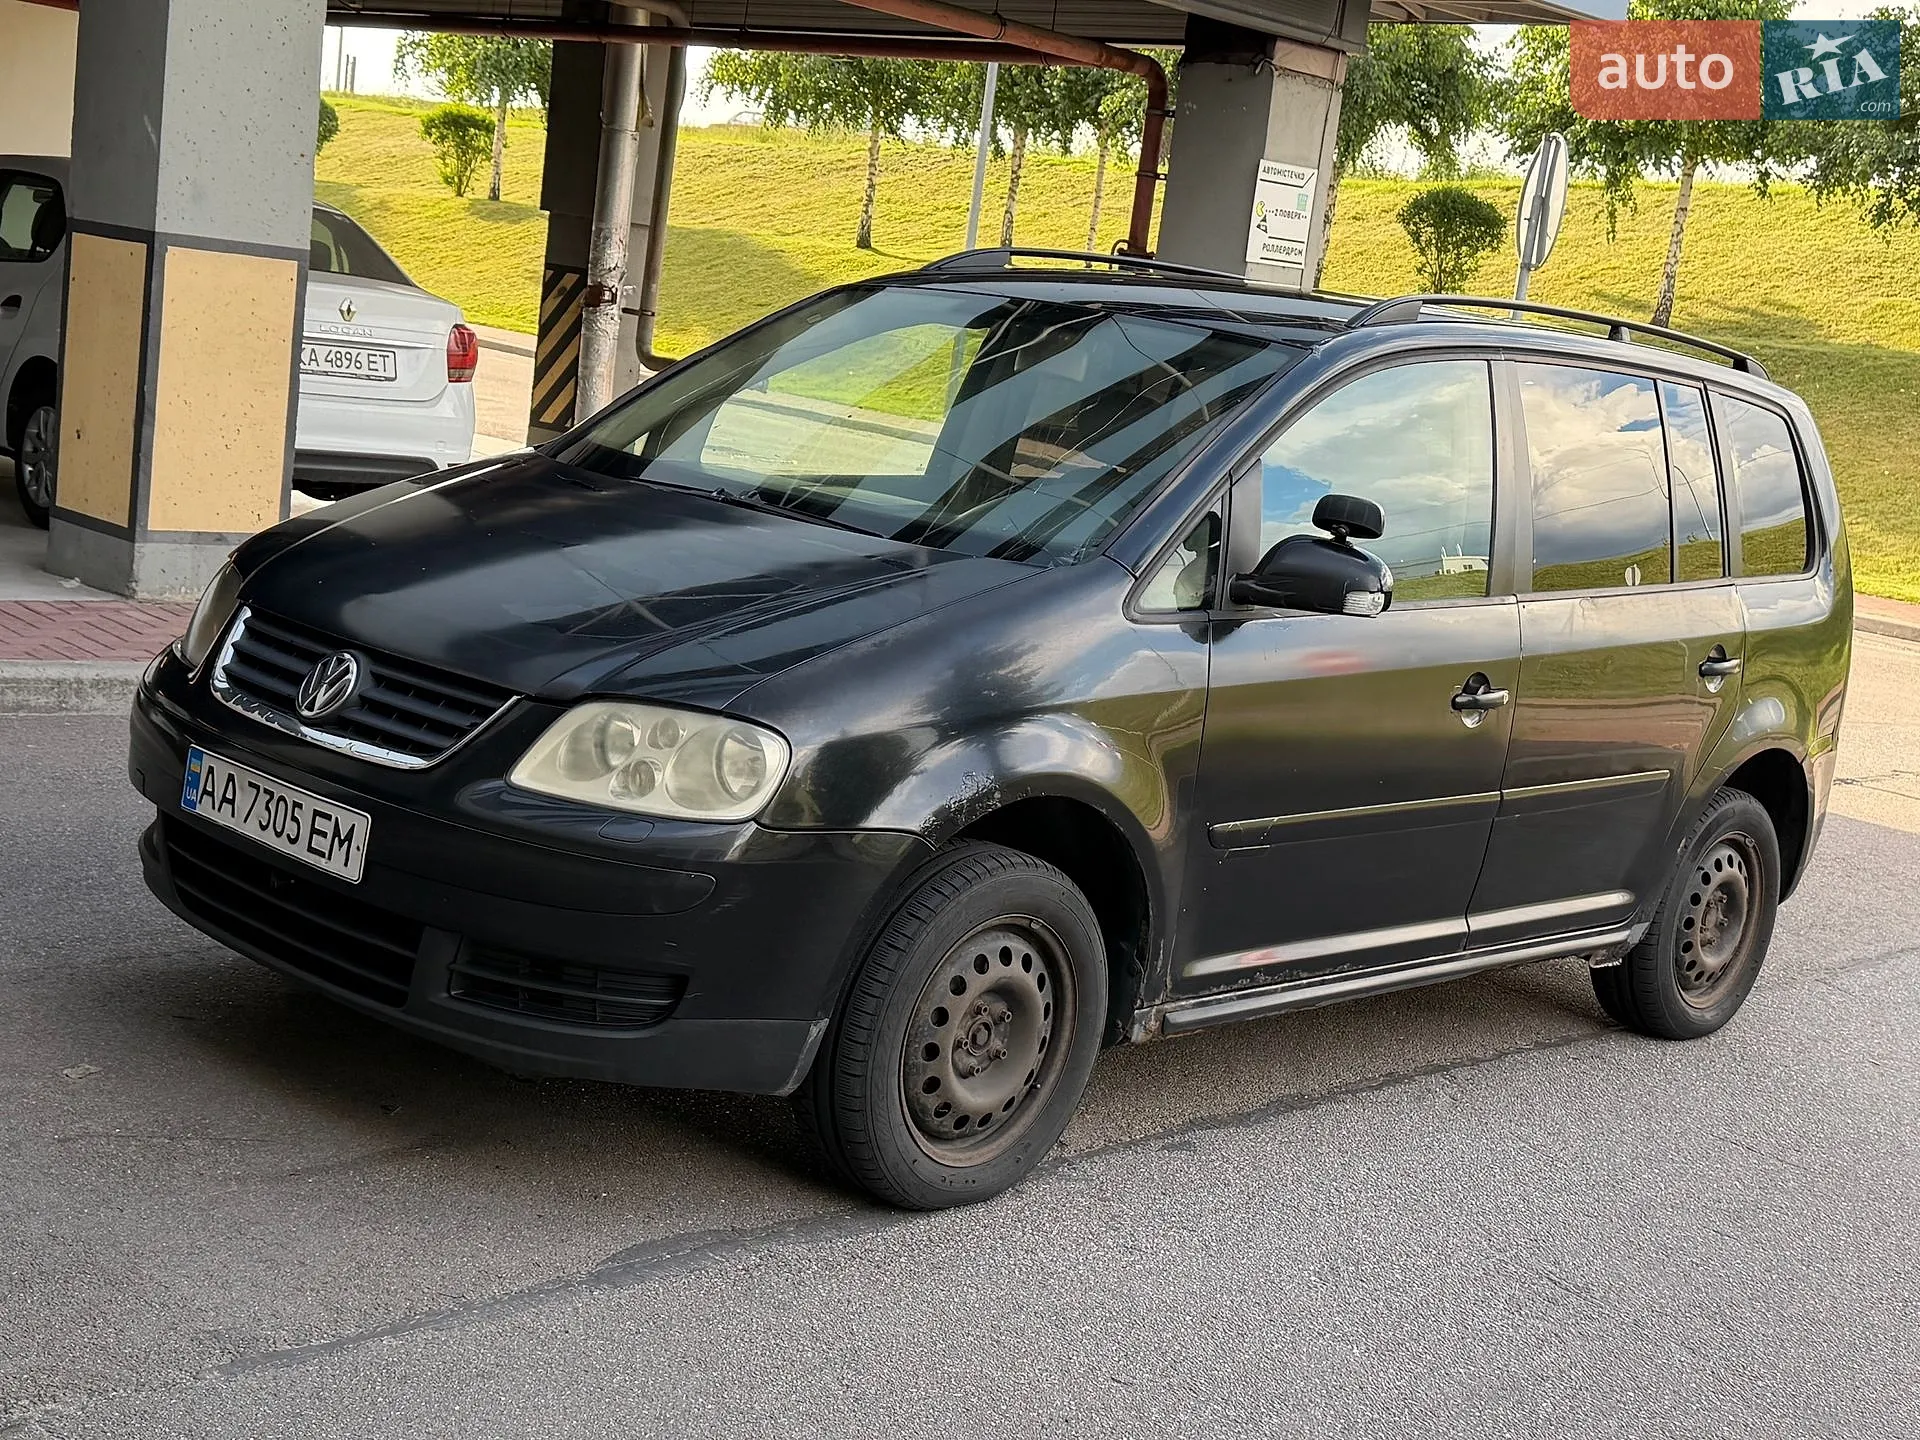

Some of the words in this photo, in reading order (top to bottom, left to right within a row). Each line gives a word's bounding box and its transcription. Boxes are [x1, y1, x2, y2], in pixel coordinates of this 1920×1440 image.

[1262, 242, 1304, 257] РОЛЛЕРДРОМ
[319, 325, 373, 336] LOGAN
[324, 349, 363, 369] 4896
[367, 353, 390, 373] ET
[186, 786, 198, 802] UA
[199, 765, 237, 818] AA
[243, 780, 304, 846] 7305
[306, 807, 356, 868] EM
